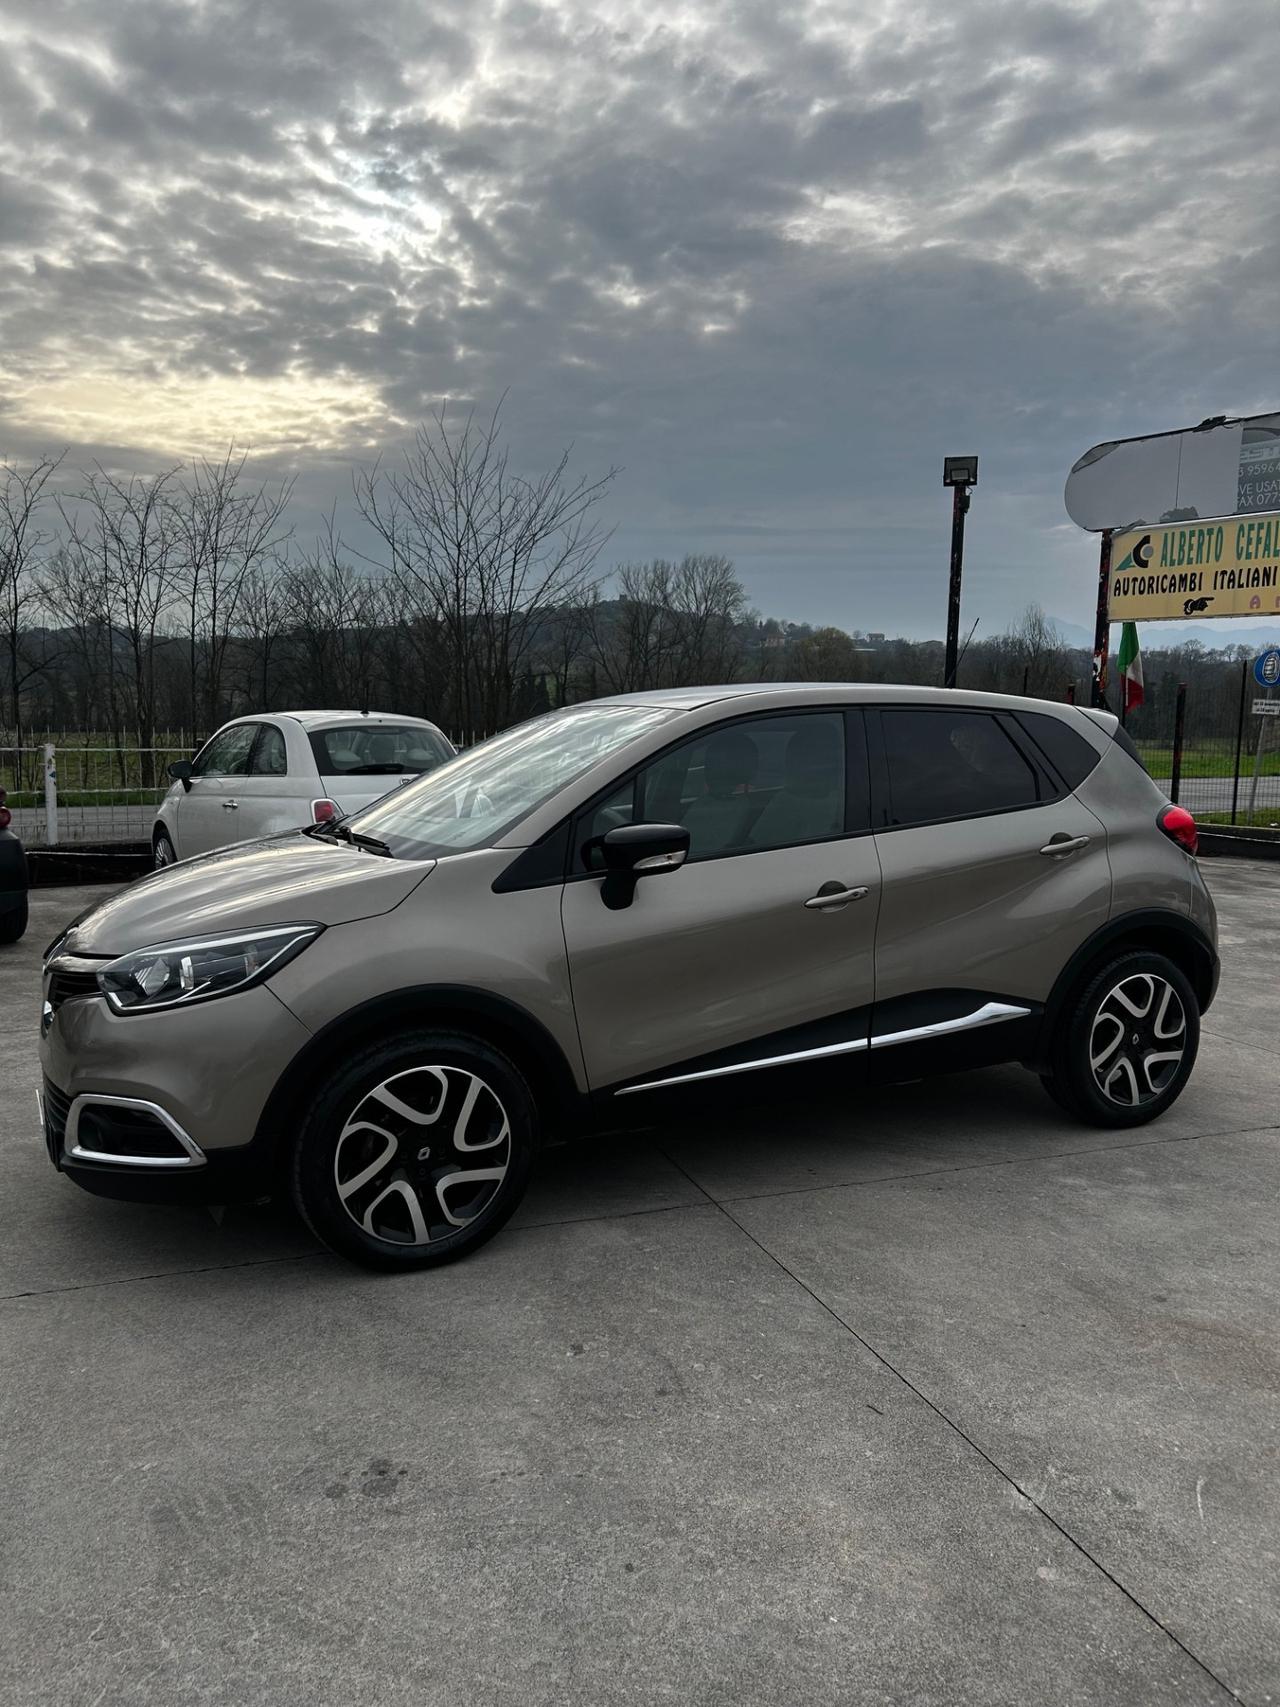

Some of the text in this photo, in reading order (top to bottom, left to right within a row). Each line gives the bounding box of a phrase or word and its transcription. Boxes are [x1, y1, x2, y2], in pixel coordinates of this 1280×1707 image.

[1160, 520, 1280, 567] ALBERTO CEFAL
[1113, 566, 1278, 597] AUTORICAMBI ITALIANI
